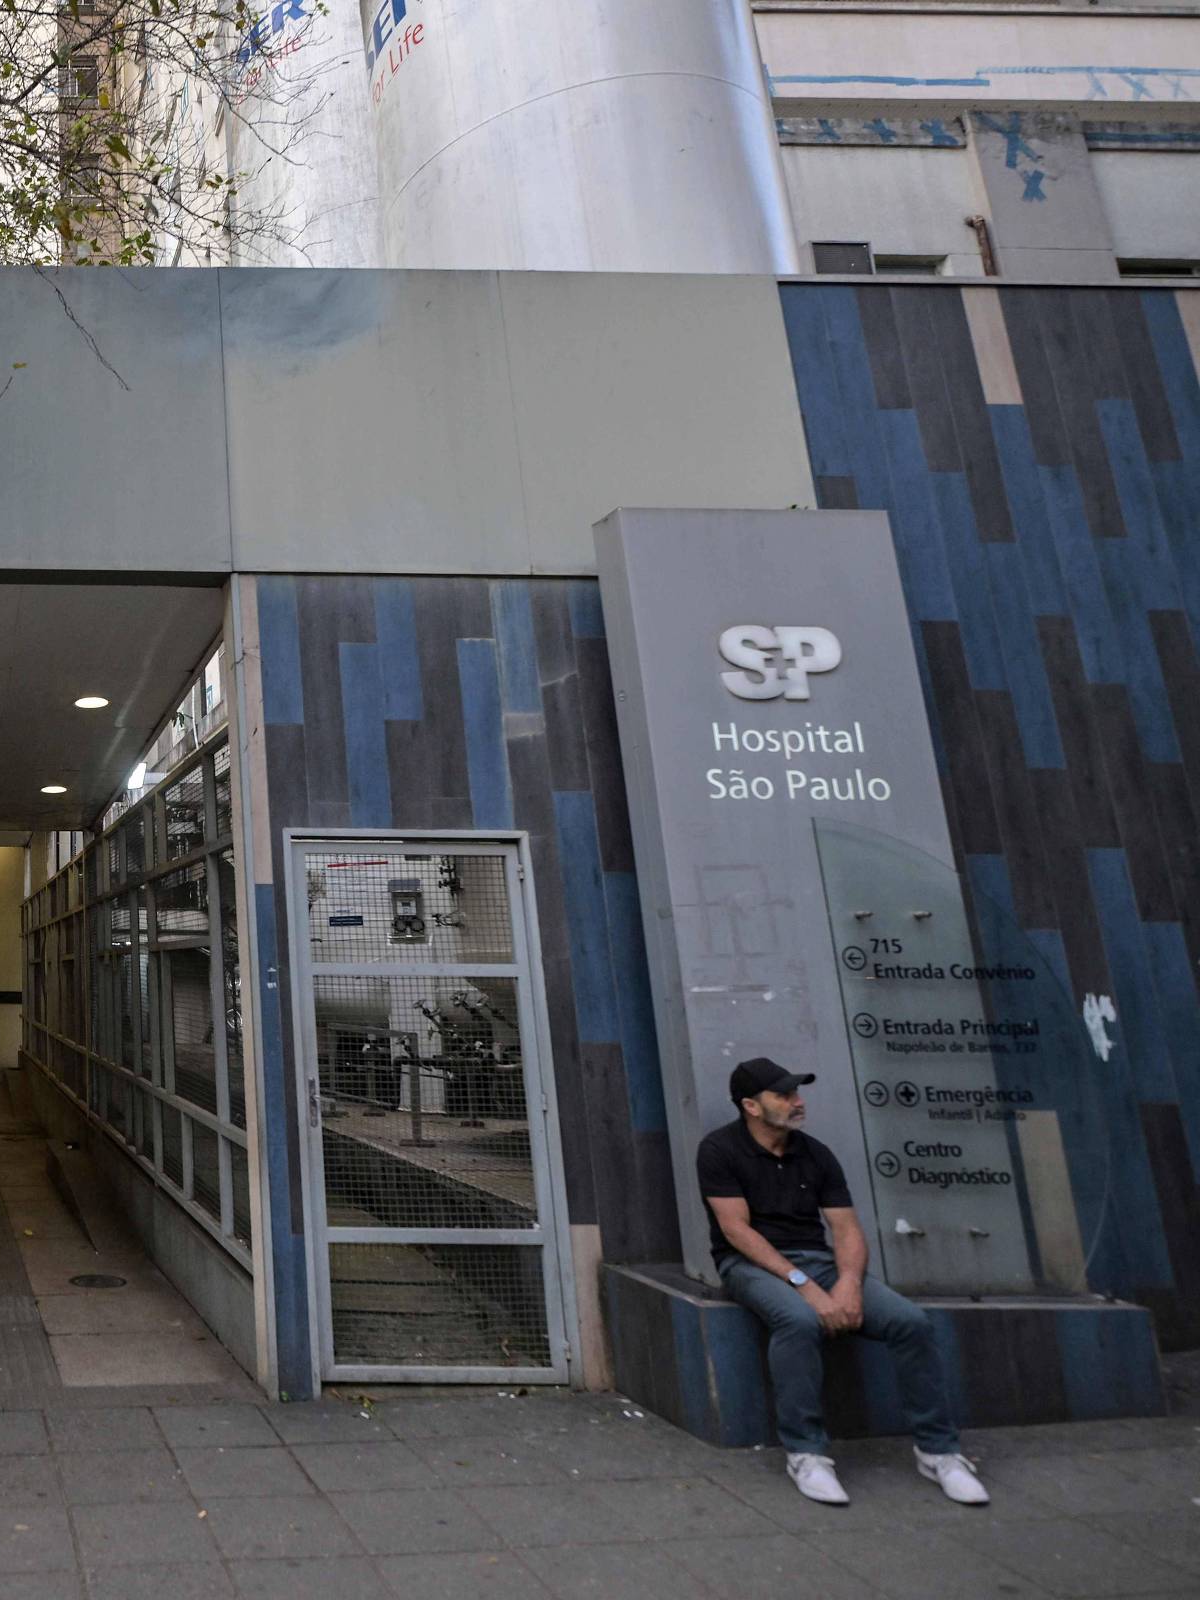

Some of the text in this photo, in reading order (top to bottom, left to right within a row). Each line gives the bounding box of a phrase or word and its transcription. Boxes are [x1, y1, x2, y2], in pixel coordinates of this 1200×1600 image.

[389, 24, 425, 74] Life
[711, 721, 865, 760] Hospital
[706, 768, 891, 801] São Paulo
[869, 938, 903, 954] 715
[874, 963, 1036, 981] Entrada Convênio
[883, 1018, 1040, 1039] Entrada Principal
[925, 1086, 1034, 1106] Emergência
[904, 1140, 963, 1158] Centro
[908, 1167, 1011, 1189] Diagnóstico
